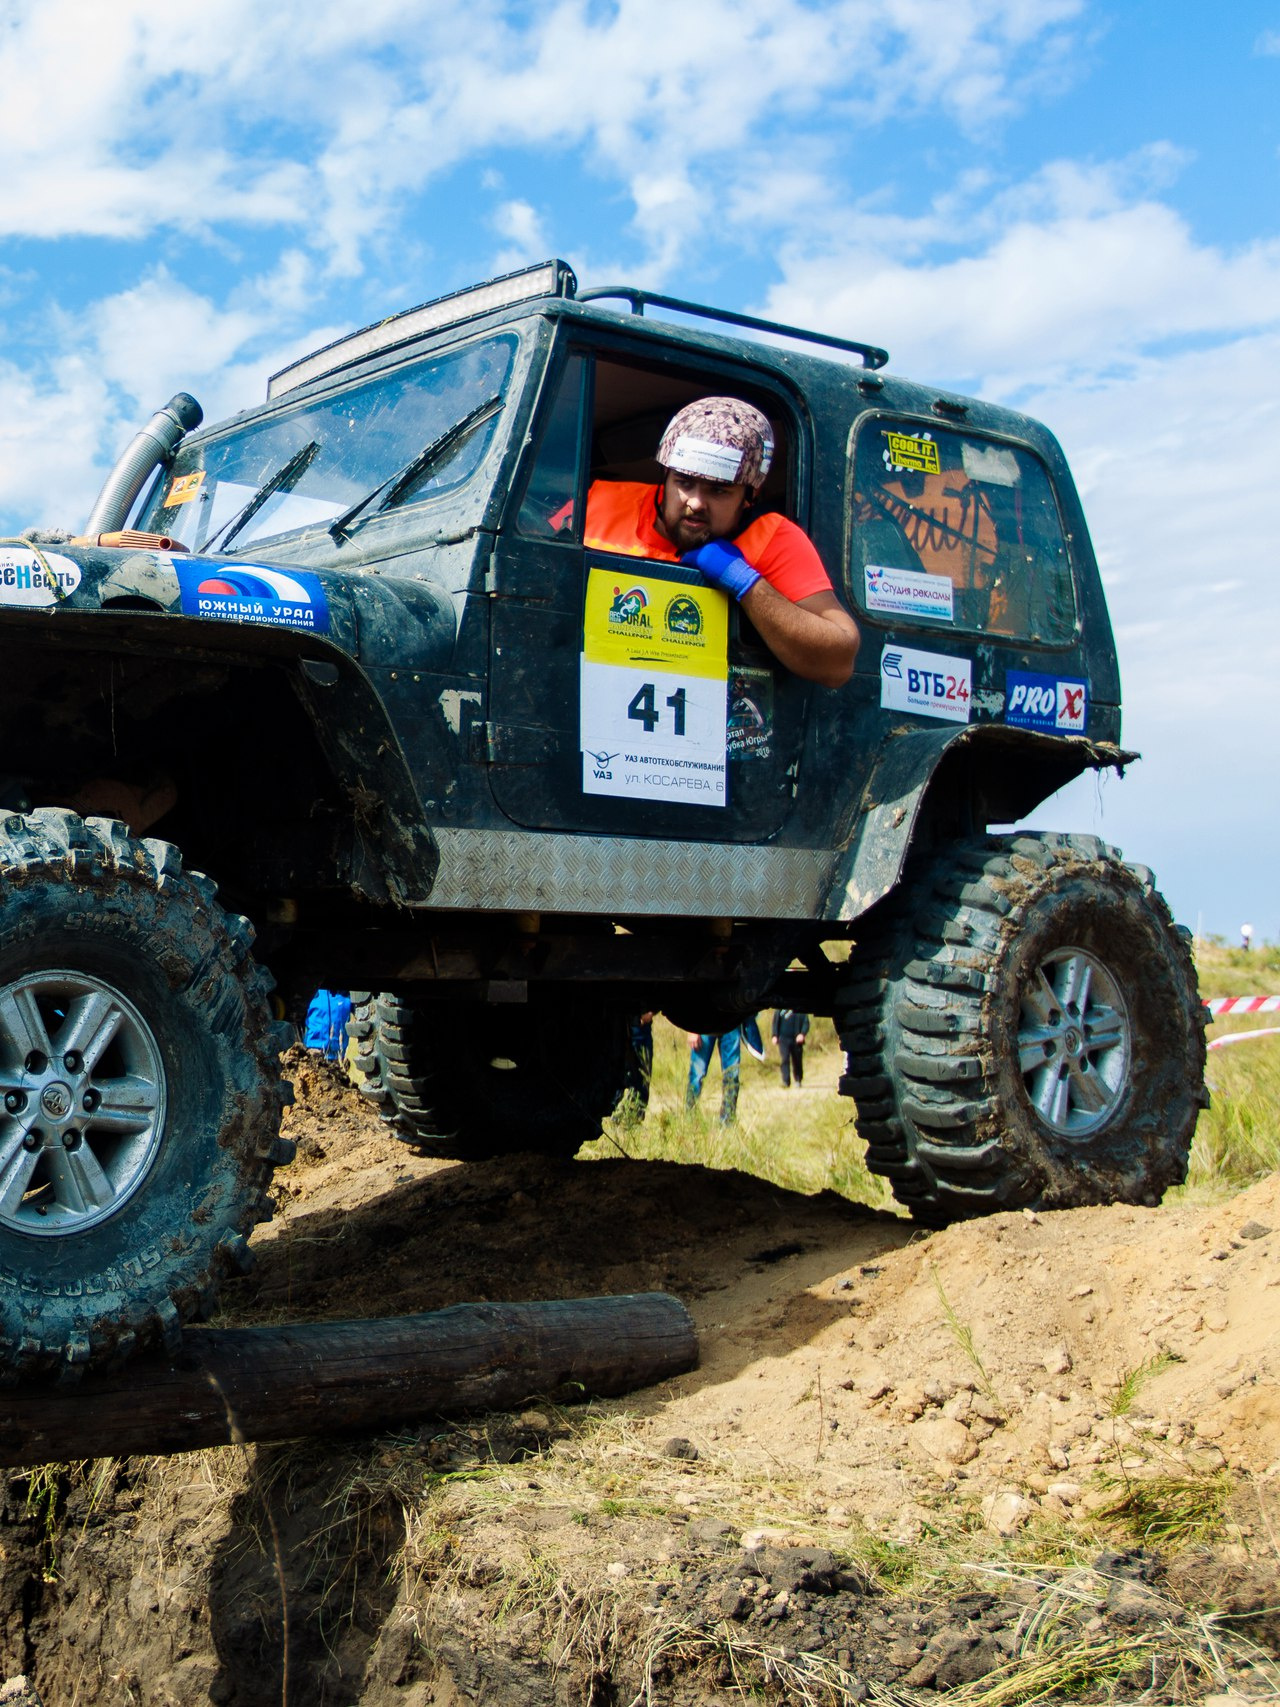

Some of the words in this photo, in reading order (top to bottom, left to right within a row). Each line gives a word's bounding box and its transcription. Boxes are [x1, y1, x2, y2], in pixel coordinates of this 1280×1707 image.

[892, 437, 920, 453] COOL
[922, 444, 932, 456] IT
[882, 582, 911, 596] Студия
[198, 599, 263, 615] ЮЖНЫЙ
[272, 606, 314, 619] УРАЛ
[200, 611, 315, 627] ГОСТЕЛЕРАДИОКОМПАНИЯ
[626, 613, 653, 629] URAL
[607, 629, 653, 640] CHALLENGE
[661, 637, 706, 648] CHALLENGE
[908, 668, 969, 702] ВТБ24
[627, 683, 686, 736] 41
[625, 754, 638, 763] УАЗ
[640, 756, 724, 773] АВТОТЕХОБСЛУЖИВАНИЕ
[593, 770, 612, 780] УАЗ
[716, 781, 724, 792] 6
